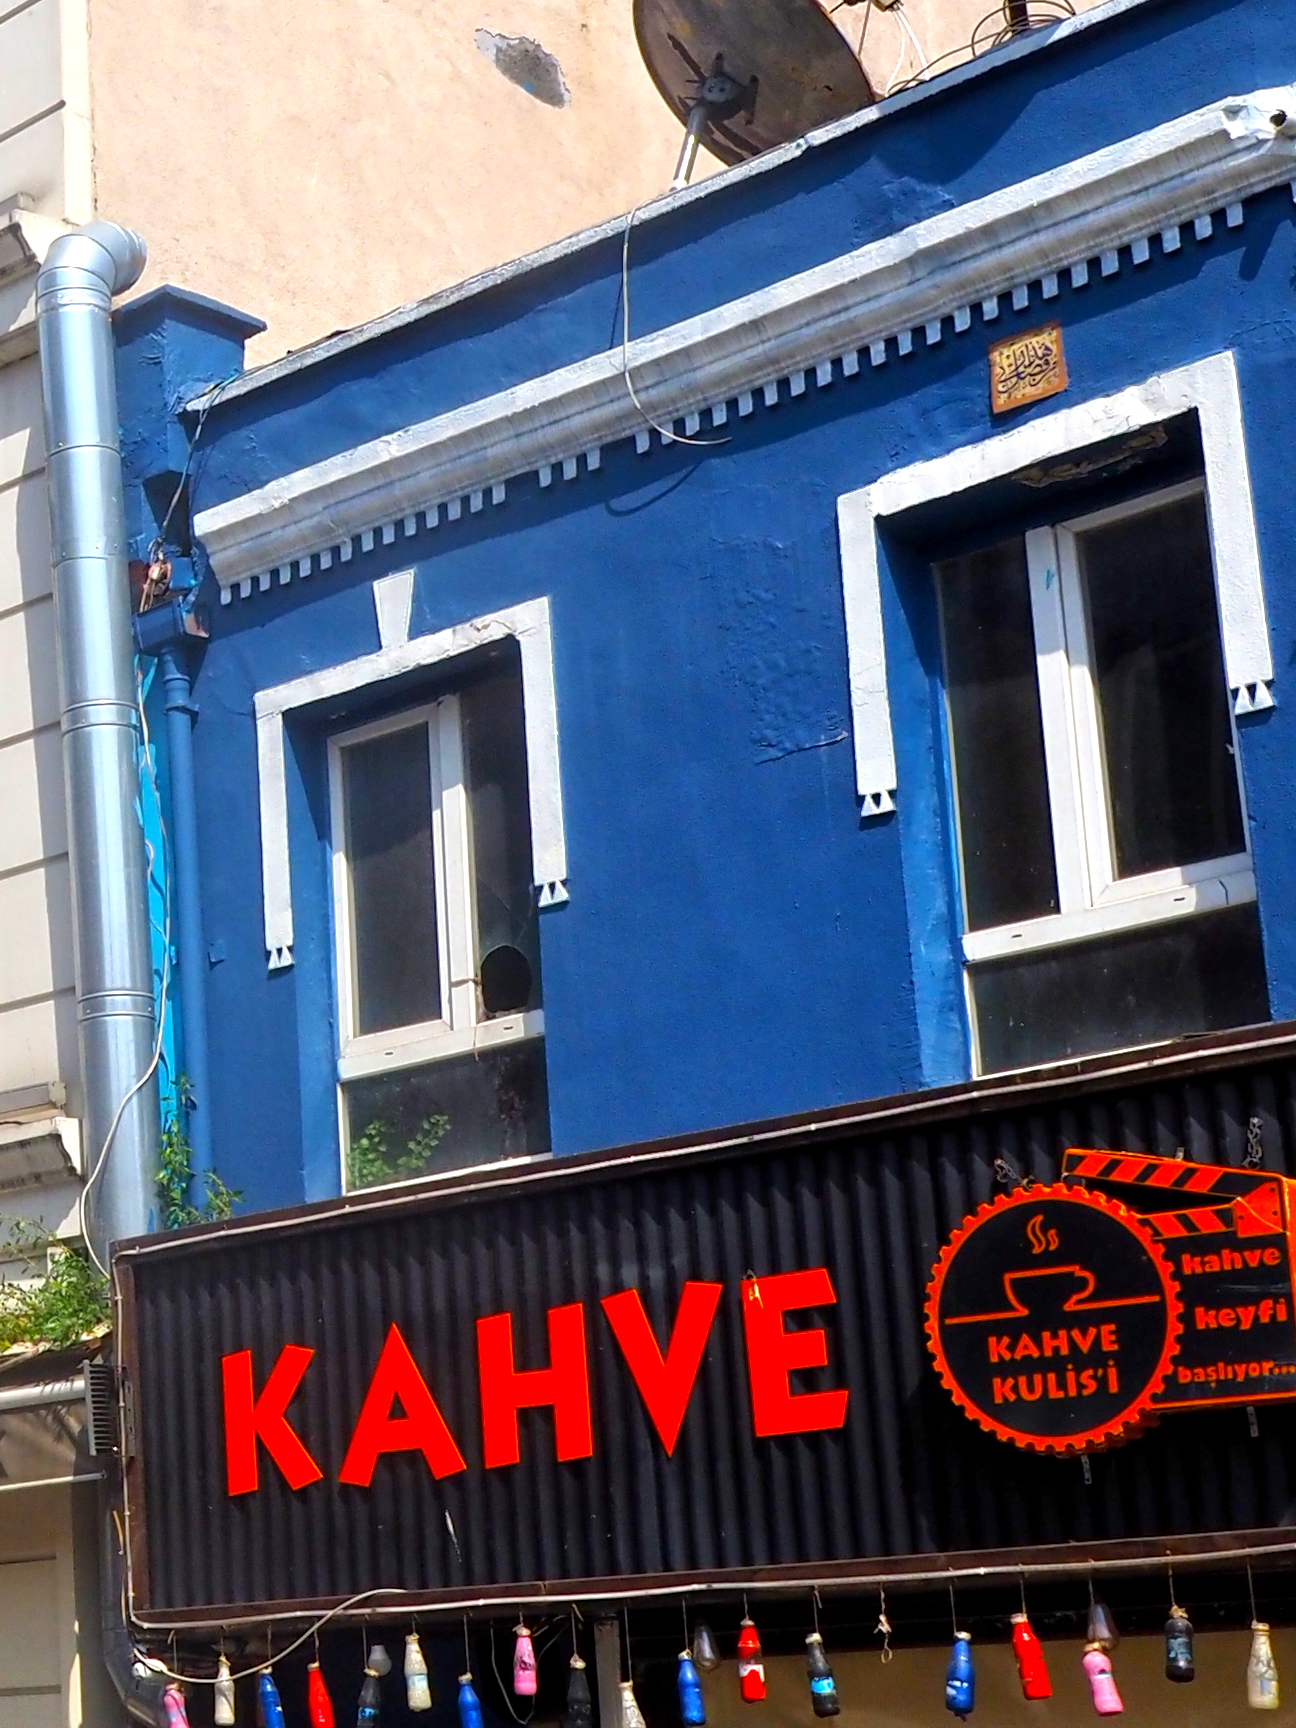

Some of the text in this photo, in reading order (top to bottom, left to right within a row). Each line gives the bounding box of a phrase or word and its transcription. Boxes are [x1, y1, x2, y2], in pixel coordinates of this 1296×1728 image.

[1181, 1246, 1282, 1276] kahve
[1193, 1297, 1289, 1331] keyfi
[987, 1323, 1119, 1364] KAHVE
[221, 1268, 849, 1497] KAHVE
